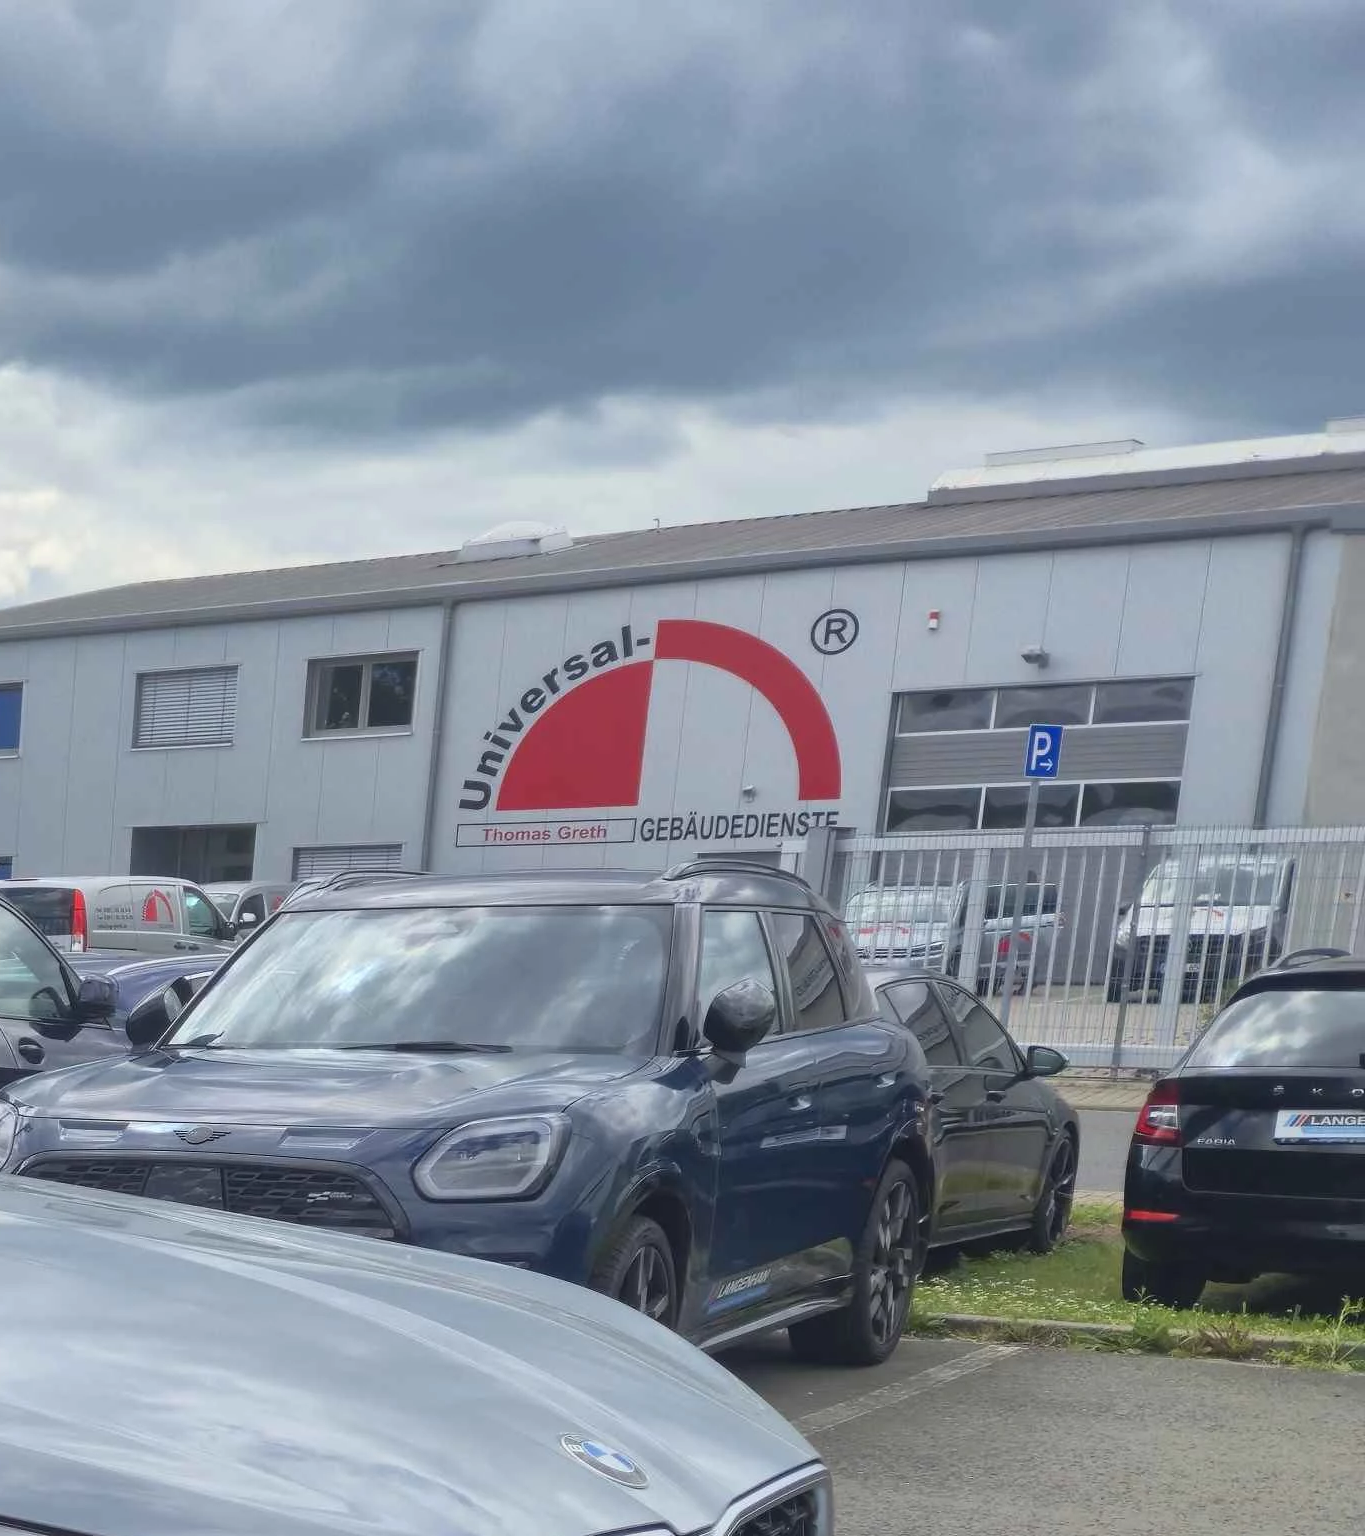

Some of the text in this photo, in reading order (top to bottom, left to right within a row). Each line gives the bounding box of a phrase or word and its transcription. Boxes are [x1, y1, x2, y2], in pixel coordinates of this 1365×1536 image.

[459, 625, 651, 811] Universal-
[1031, 731, 1052, 771] P
[483, 824, 608, 842] Thomas Greth
[1310, 1115, 1365, 1126] LANGE
